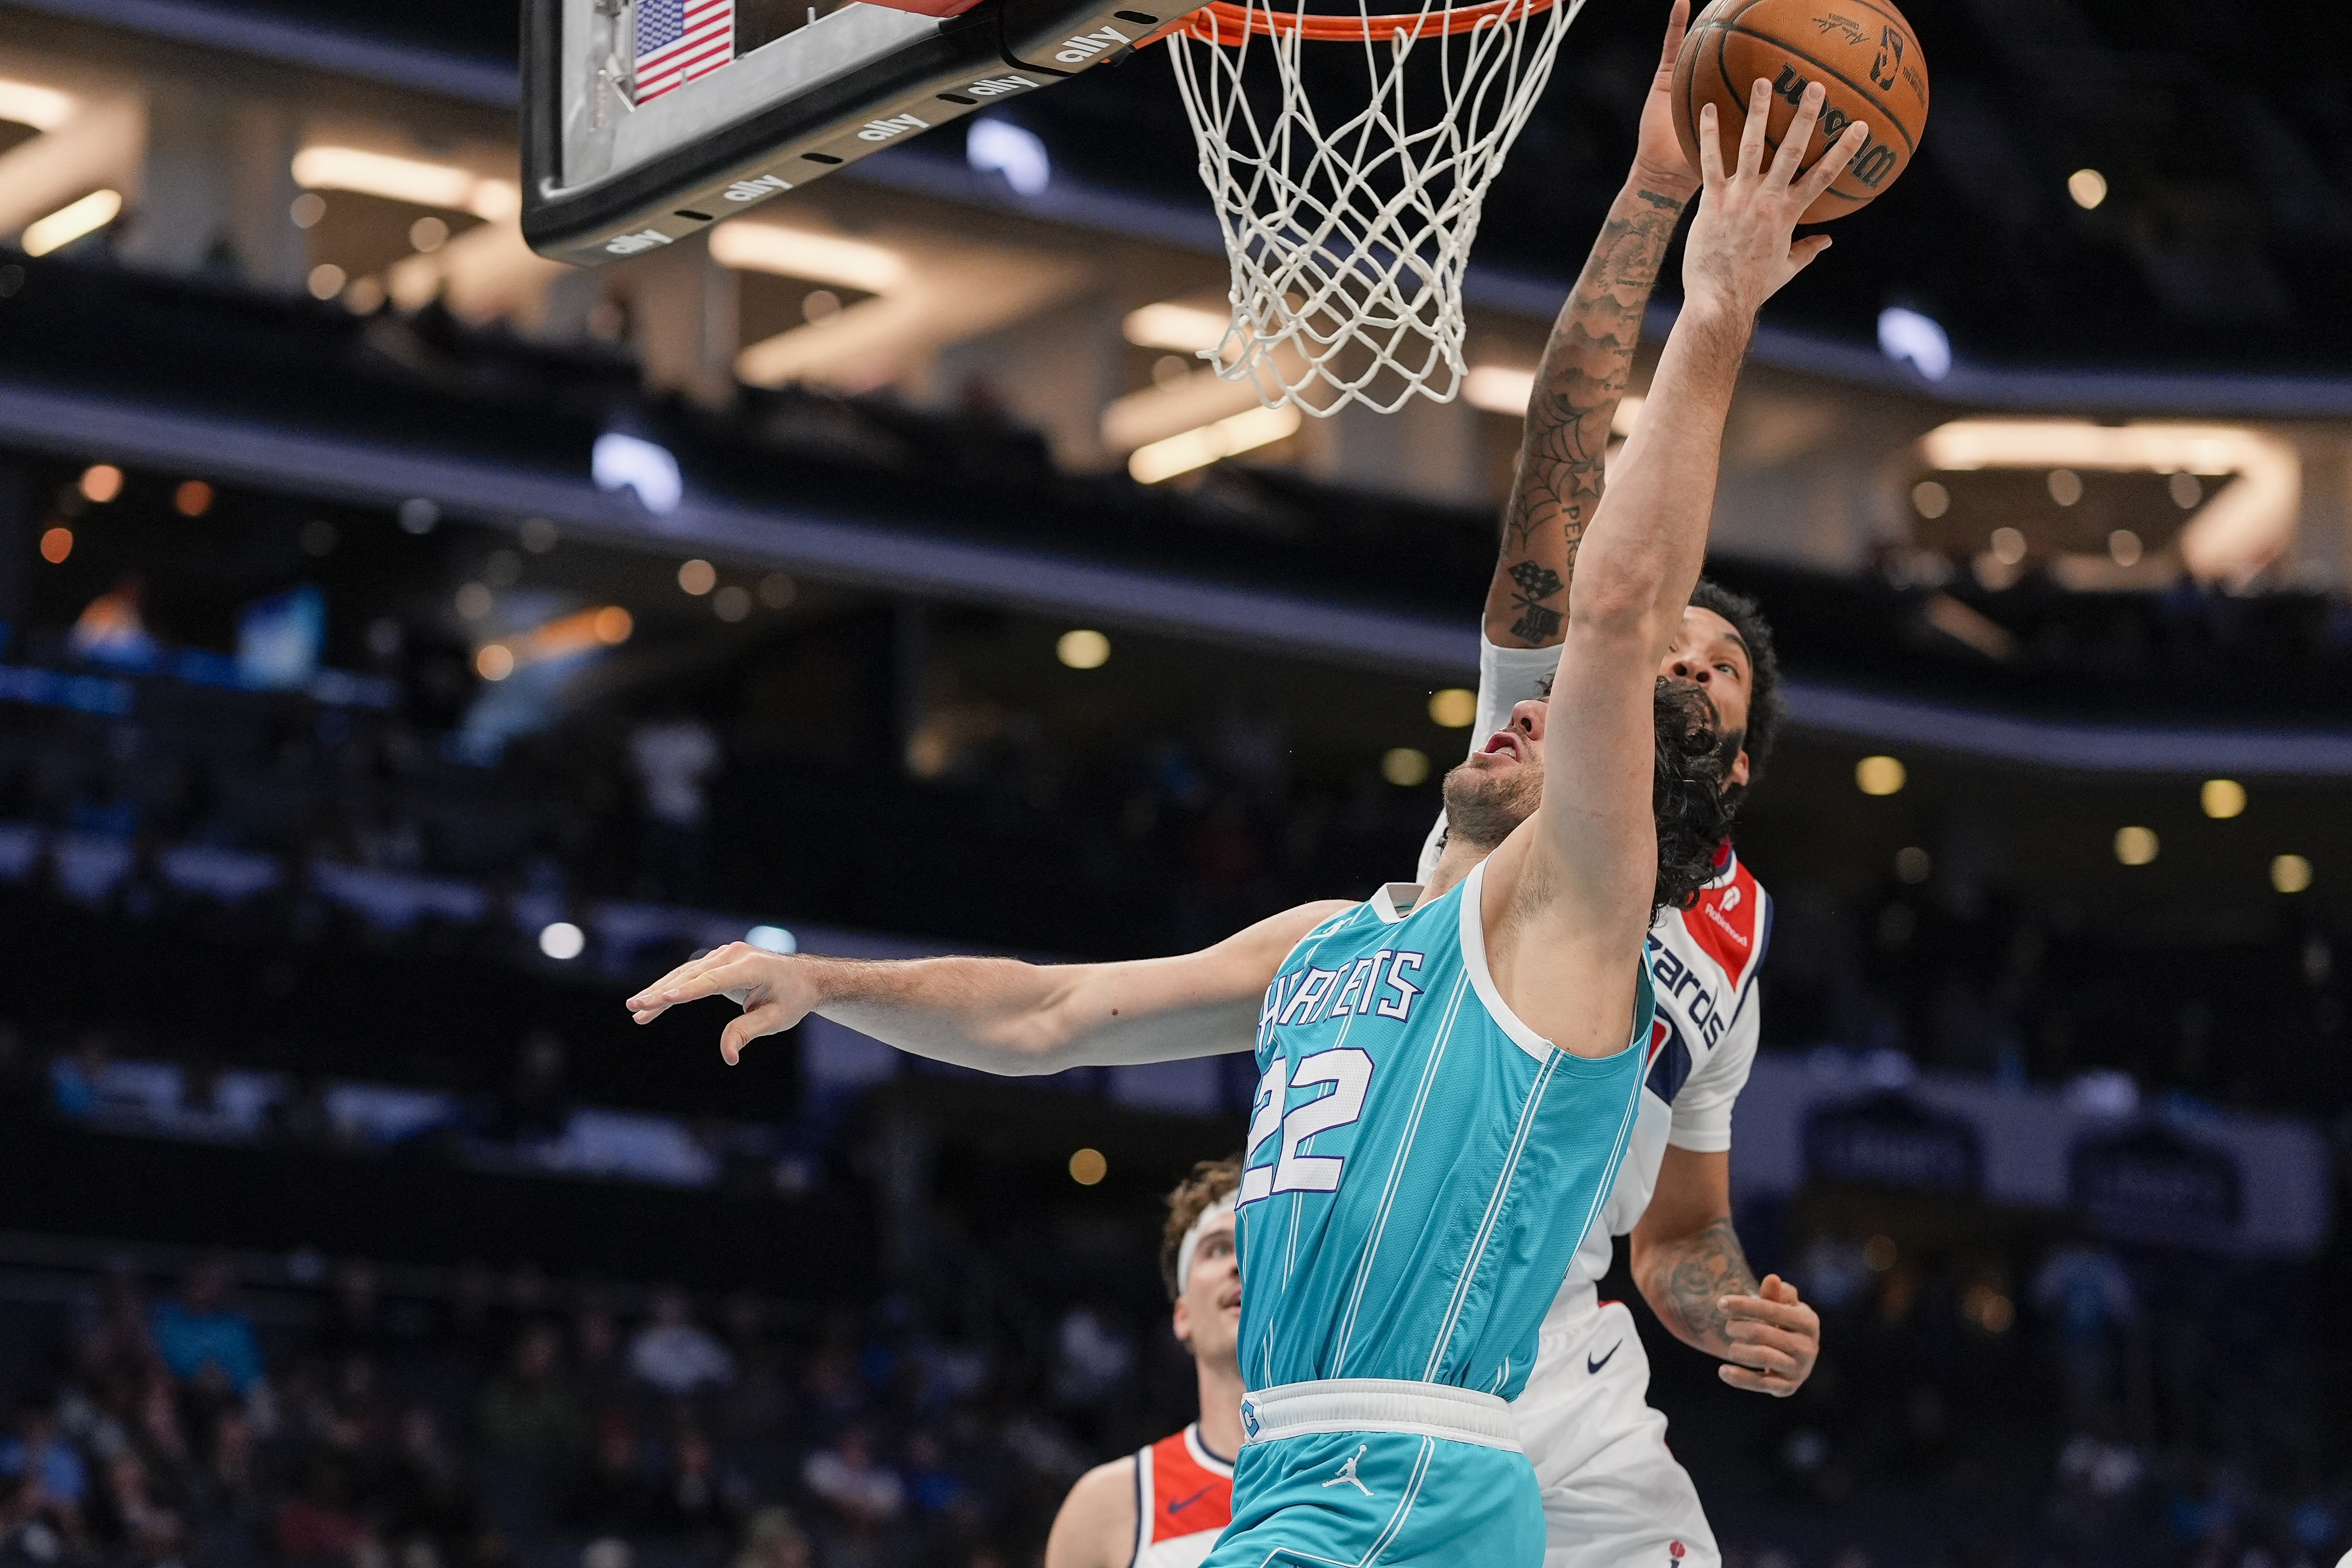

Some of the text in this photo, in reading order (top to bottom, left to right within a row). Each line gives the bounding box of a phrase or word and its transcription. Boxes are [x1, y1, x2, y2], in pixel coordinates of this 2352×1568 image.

[1055, 25, 1132, 63] ally
[968, 75, 1040, 96] ally
[857, 113, 931, 141] ally
[723, 174, 794, 202] ally
[1234, 1047, 1376, 1211] 22
